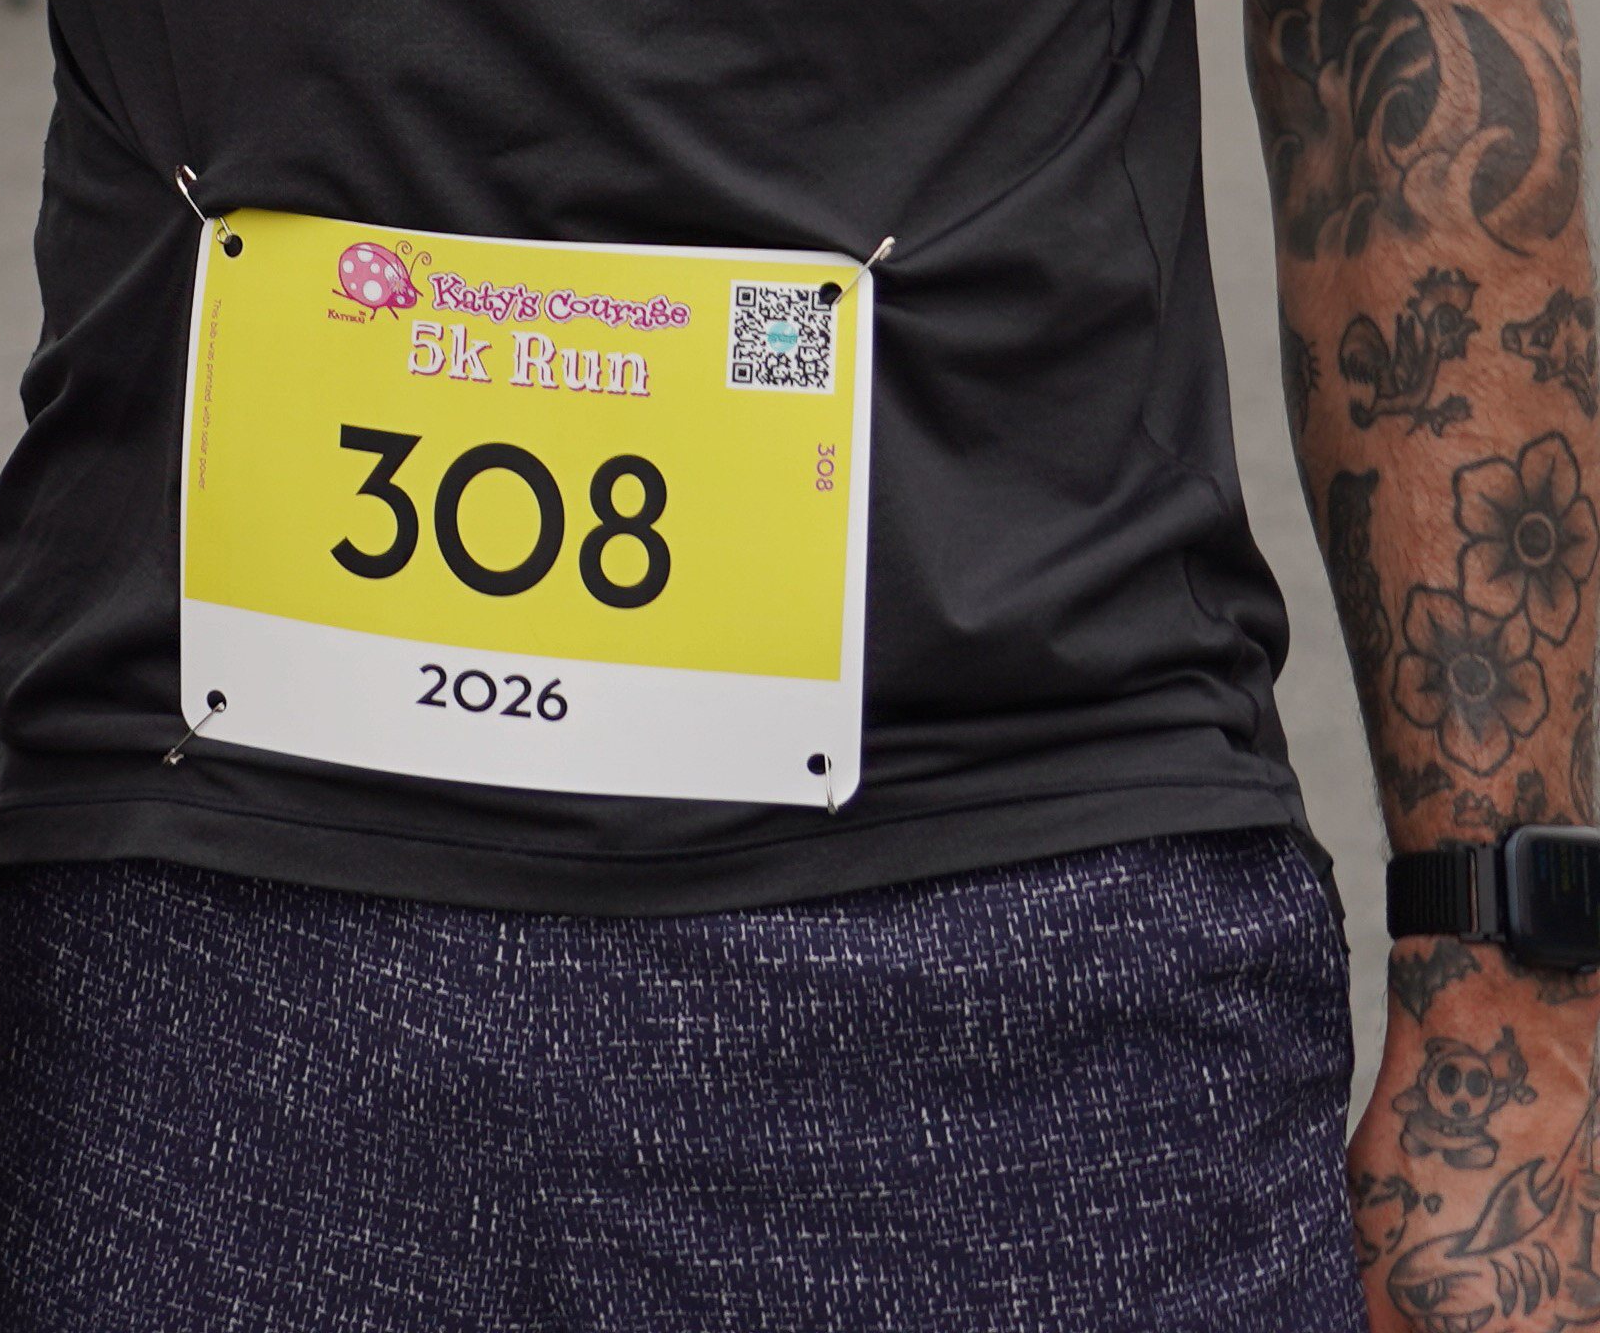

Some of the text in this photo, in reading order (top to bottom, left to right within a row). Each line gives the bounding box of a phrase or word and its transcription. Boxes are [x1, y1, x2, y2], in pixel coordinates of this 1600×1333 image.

[429, 272, 692, 331] Katy's Courage
[408, 319, 650, 397] 5k Run
[816, 442, 835, 492] 308
[330, 424, 671, 610] 308
[416, 663, 568, 721] 2026
